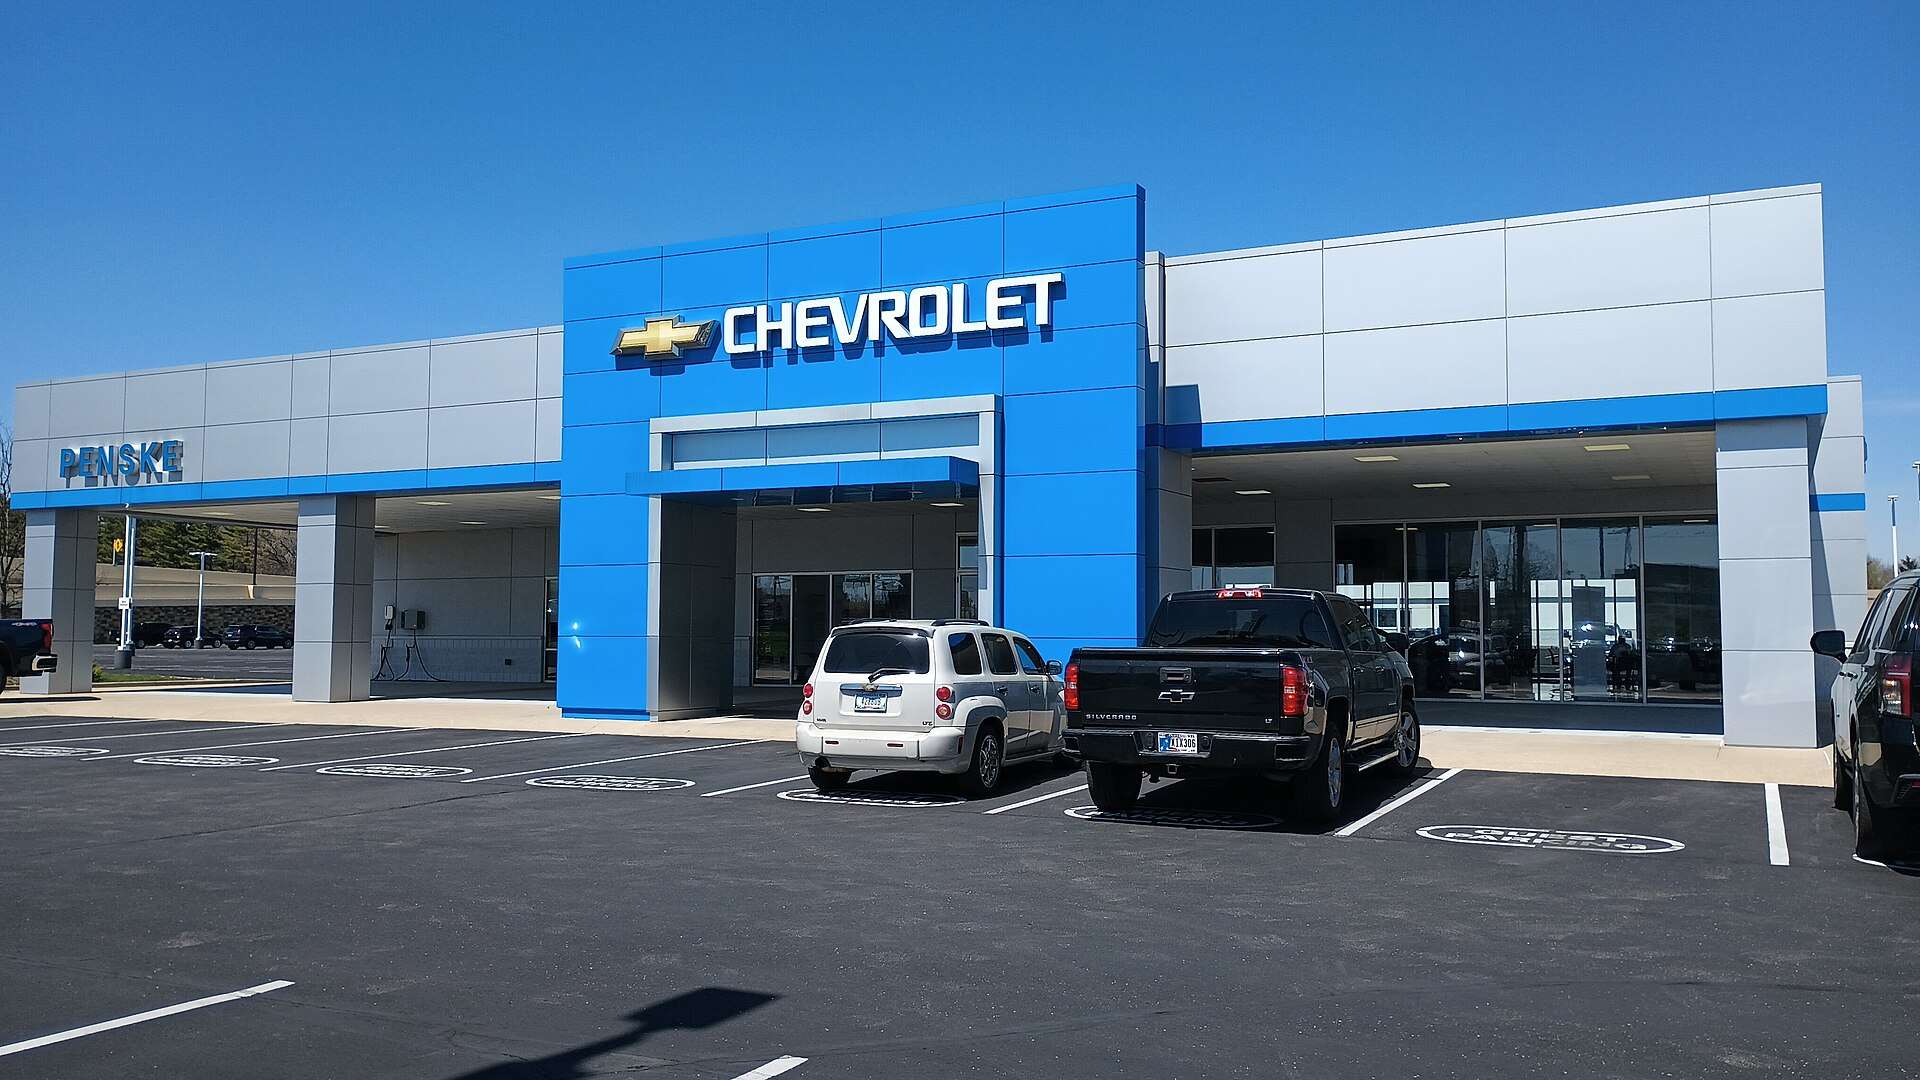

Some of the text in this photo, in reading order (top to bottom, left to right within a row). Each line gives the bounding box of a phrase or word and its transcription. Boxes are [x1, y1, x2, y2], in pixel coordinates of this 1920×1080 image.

[723, 273, 1063, 355] CHEVROLET
[60, 440, 182, 479] PENSKE
[1445, 832, 1647, 850] PARKING
[1474, 829, 1628, 843] GUEST
